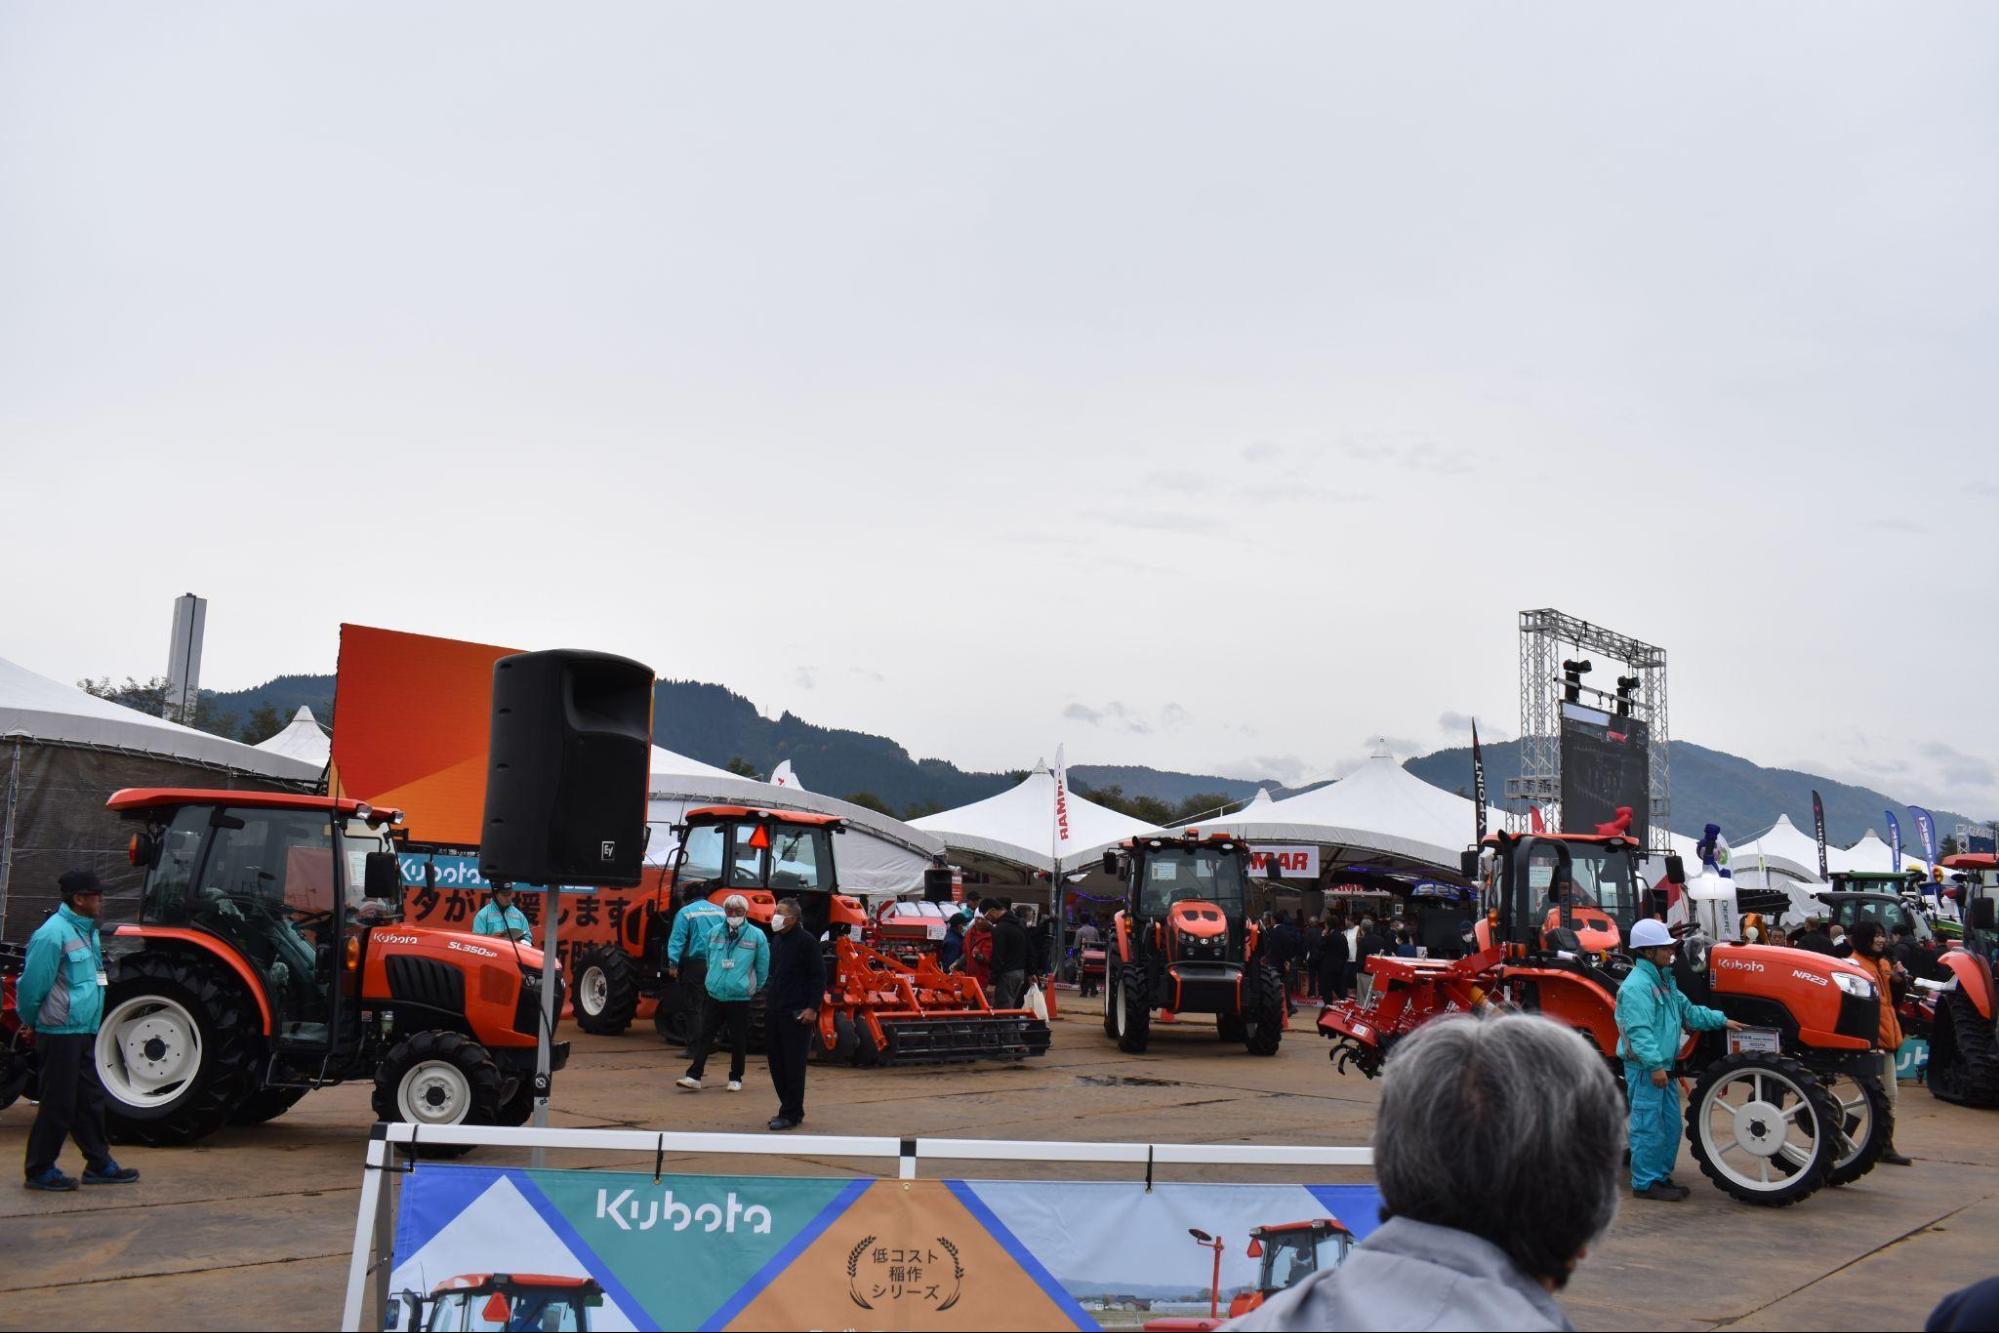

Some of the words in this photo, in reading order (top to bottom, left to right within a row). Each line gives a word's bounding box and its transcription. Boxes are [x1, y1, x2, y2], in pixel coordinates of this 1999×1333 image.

[1475, 760, 1487, 830] Y-POINT
[374, 932, 418, 944] Kubota
[1718, 958, 1765, 973] Kubota
[596, 1188, 772, 1234] Kubota
[872, 1247, 939, 1264] 低コスト
[889, 1265, 923, 1283] 稲作
[872, 1283, 940, 1300] シリーズ
